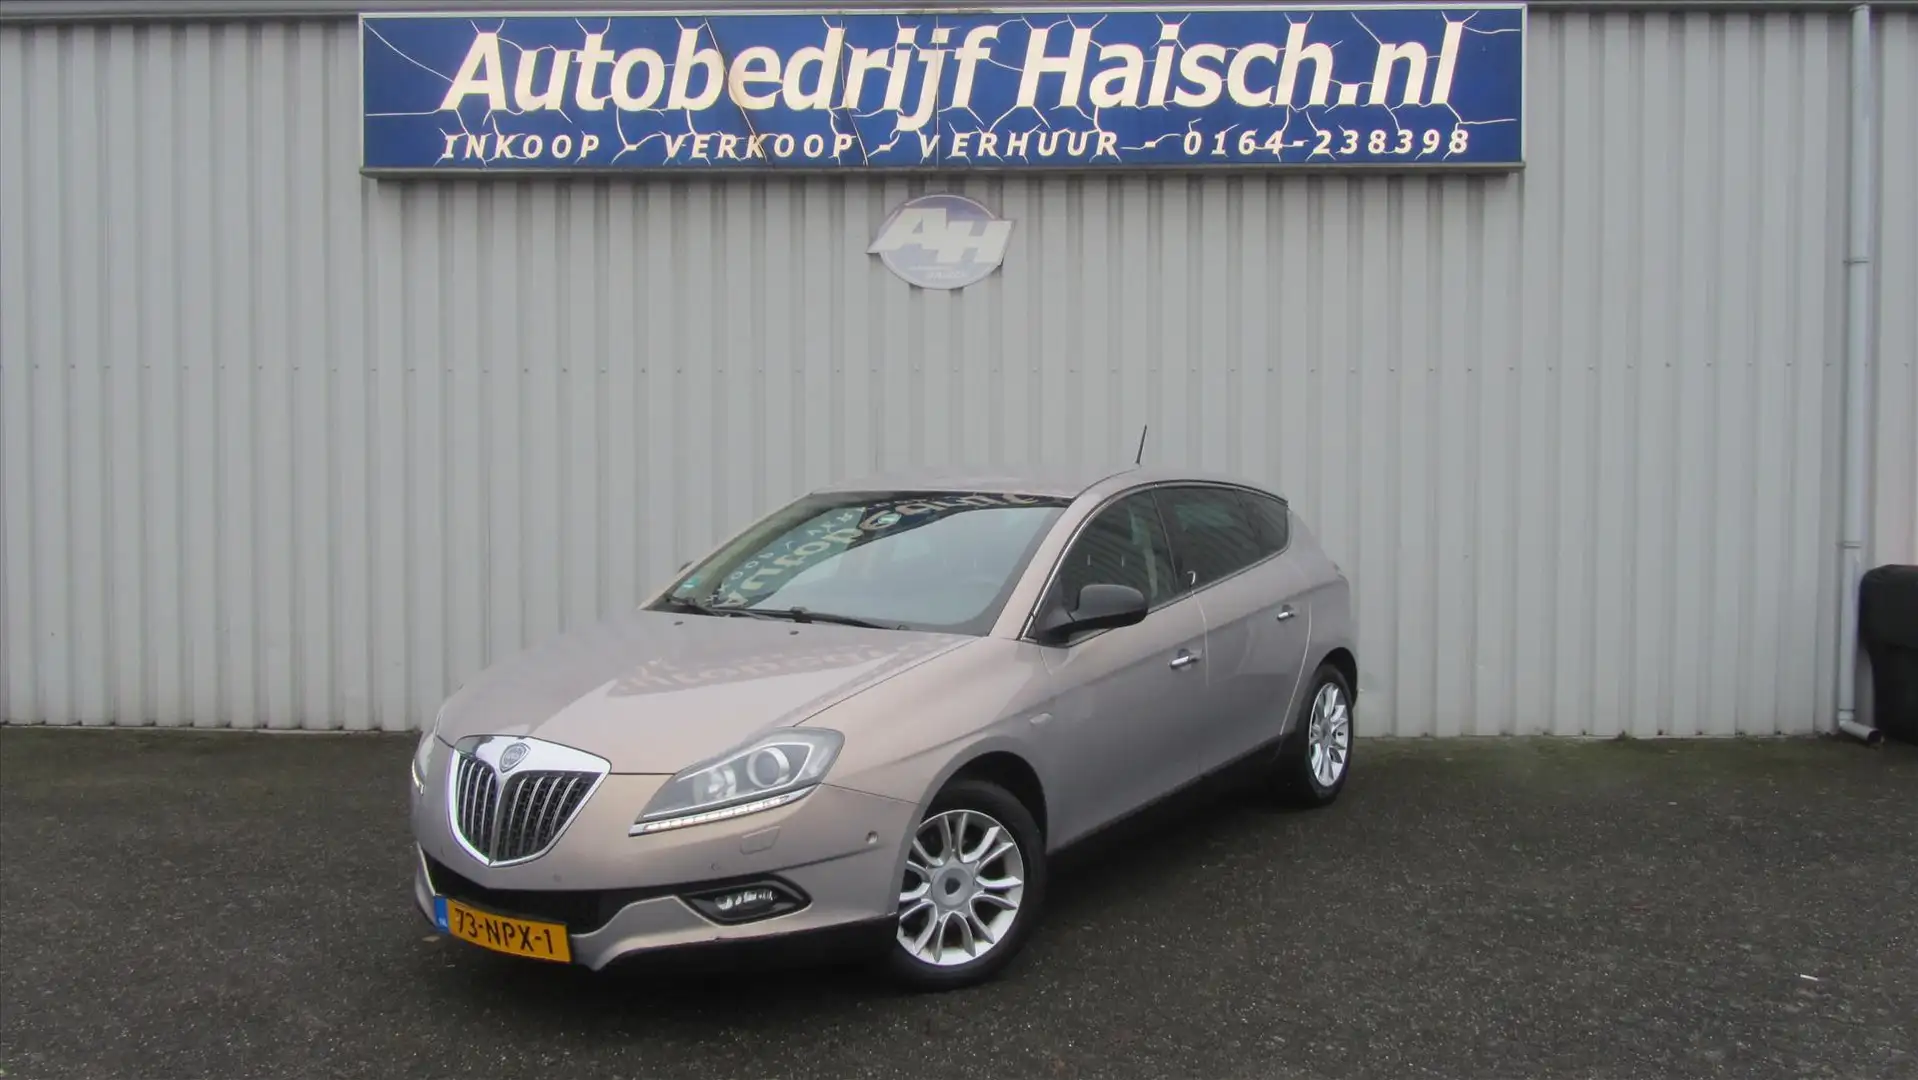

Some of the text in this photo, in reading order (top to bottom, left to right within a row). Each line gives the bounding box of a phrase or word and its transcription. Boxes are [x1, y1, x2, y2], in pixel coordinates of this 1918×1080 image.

[439, 20, 1463, 131] Autobedrijf Haisch.nl
[441, 134, 600, 158] INKOOP
[664, 133, 852, 158] VERKOOP
[920, 131, 1118, 158] VERHUUR
[1183, 129, 1470, 156] 0164-238398
[866, 208, 1013, 264] AH
[454, 907, 554, 955] 73-NPX-1
